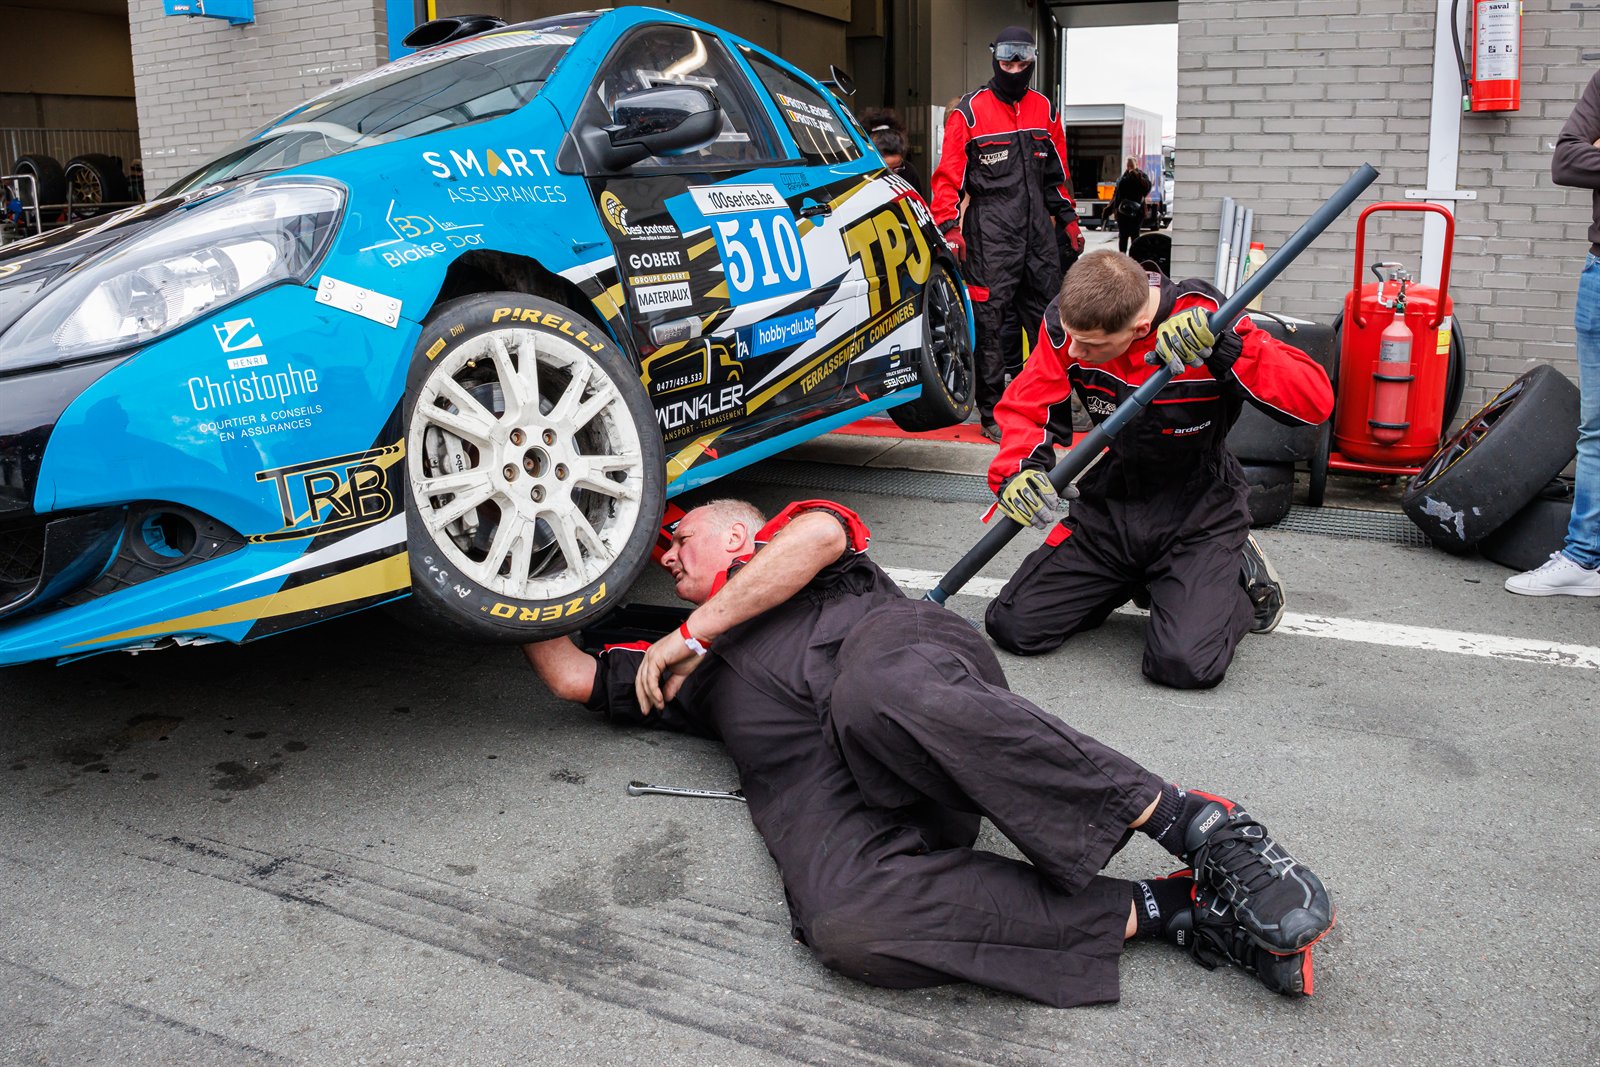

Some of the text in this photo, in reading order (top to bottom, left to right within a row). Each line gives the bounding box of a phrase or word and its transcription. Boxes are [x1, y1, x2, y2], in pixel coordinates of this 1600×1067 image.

[422, 148, 552, 179] SMART
[447, 185, 567, 203] ASSURANCES
[708, 189, 775, 209] 100series.be
[645, 223, 677, 237] partners
[382, 233, 485, 268] Blaise Dor
[629, 251, 681, 269] GOBERT
[715, 214, 803, 293] 510
[842, 198, 932, 318] TPJ
[634, 272, 686, 285] GROUPE GOBERT
[637, 287, 690, 307] MATERIAUX
[491, 306, 605, 353] PIRELLI
[758, 318, 815, 345] hobby-alu.be
[232, 356, 264, 369] HENRI
[799, 304, 915, 396] TERRASSEMENT CONTAINERS
[187, 362, 319, 411] Christophe
[656, 372, 703, 392] 0477/458.533
[199, 404, 323, 433] COURTIER & CONSEILS
[655, 383, 744, 430] WINKLER
[219, 418, 312, 442] EN ASSURANCES
[664, 425, 694, 442] ANSPORT
[700, 407, 745, 428] TERRASSEMENT
[1173, 419, 1212, 435] ardeca
[254, 446, 400, 534] TRB
[1199, 809, 1221, 832] sparco
